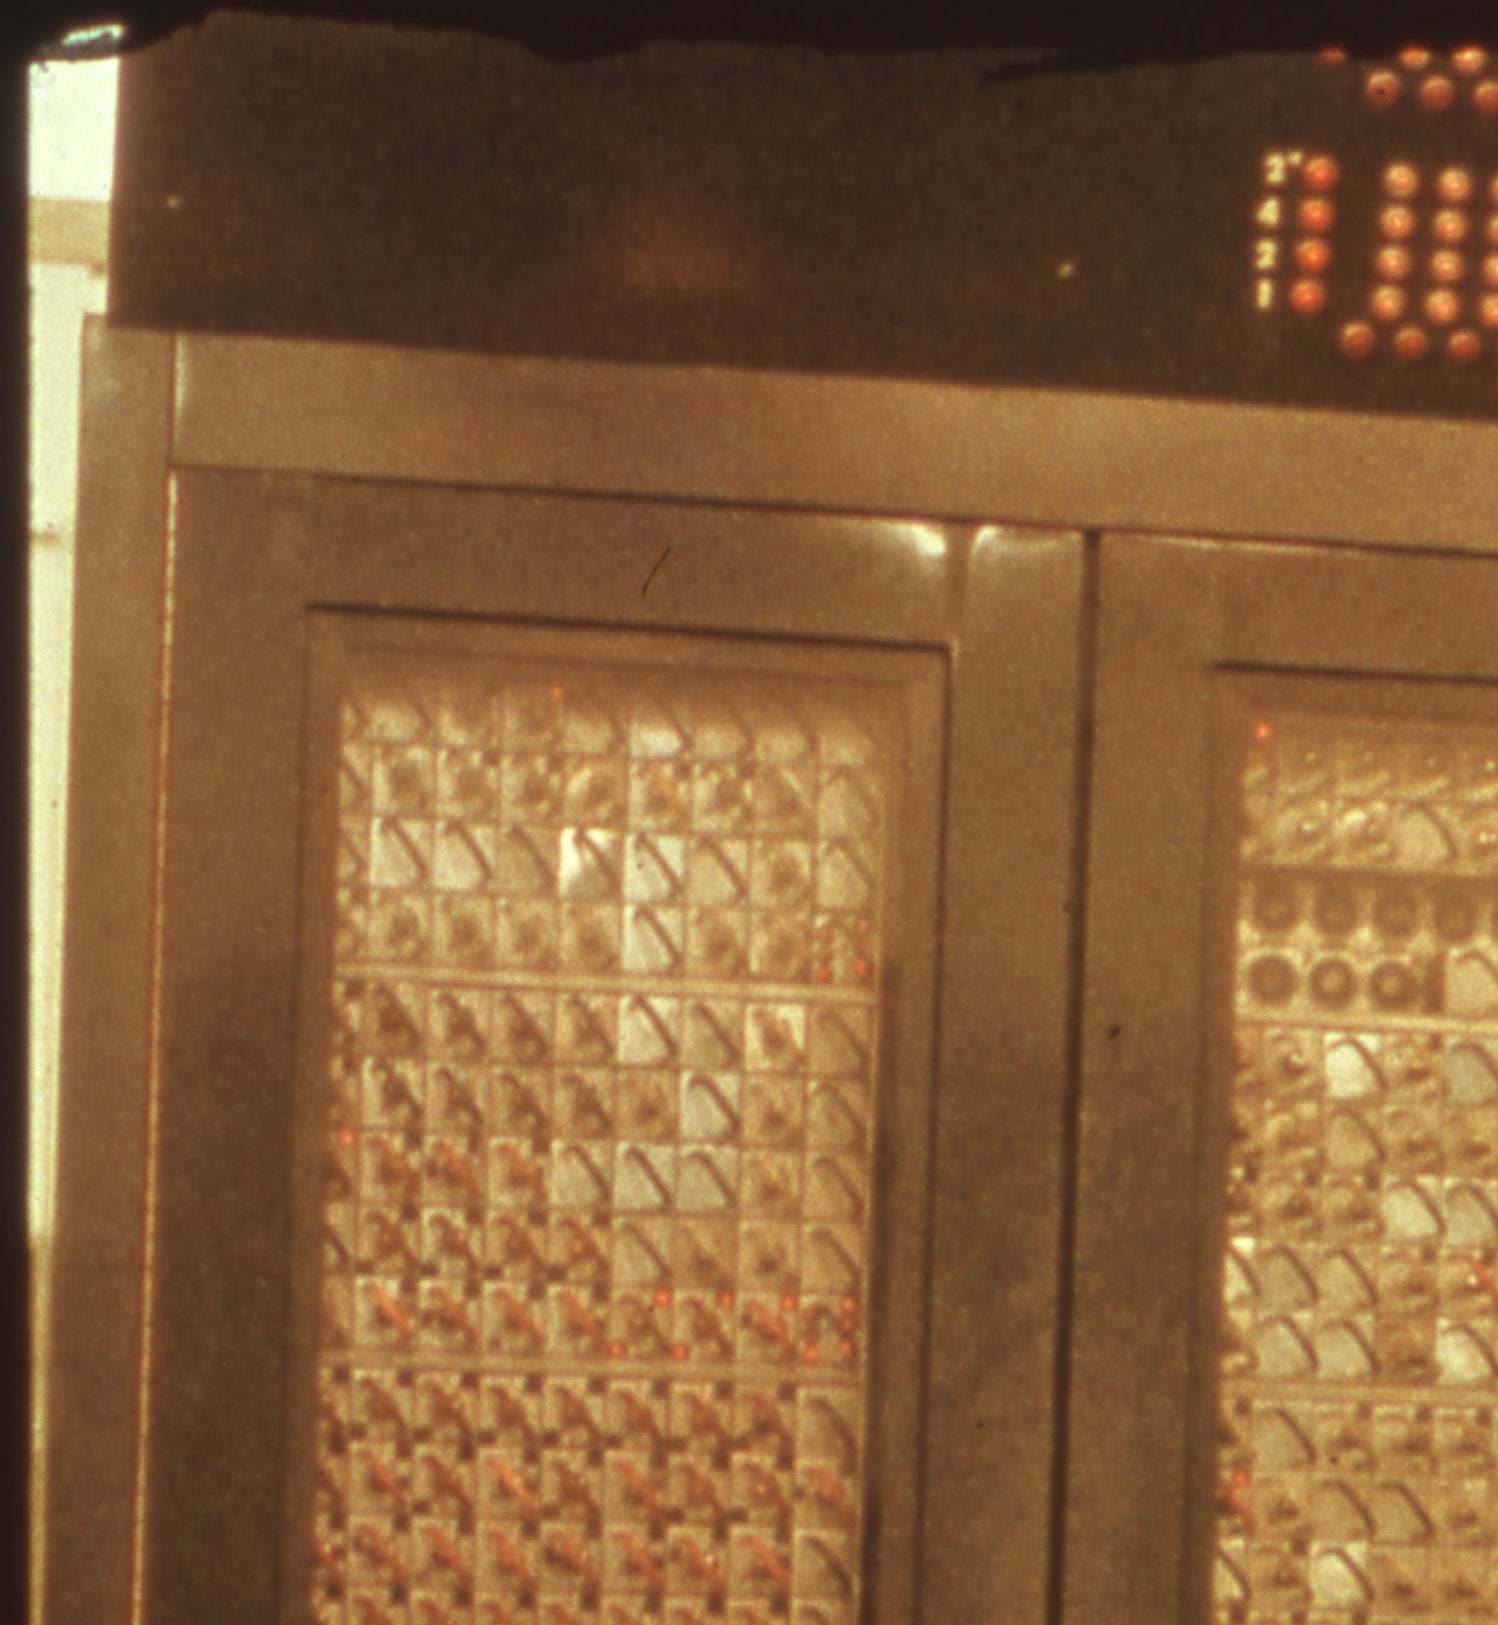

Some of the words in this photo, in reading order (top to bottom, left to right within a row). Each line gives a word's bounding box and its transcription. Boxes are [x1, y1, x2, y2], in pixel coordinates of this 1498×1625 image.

[1256, 196, 1279, 226] 4
[1255, 239, 1276, 271] 2
[1256, 278, 1273, 310] 1
